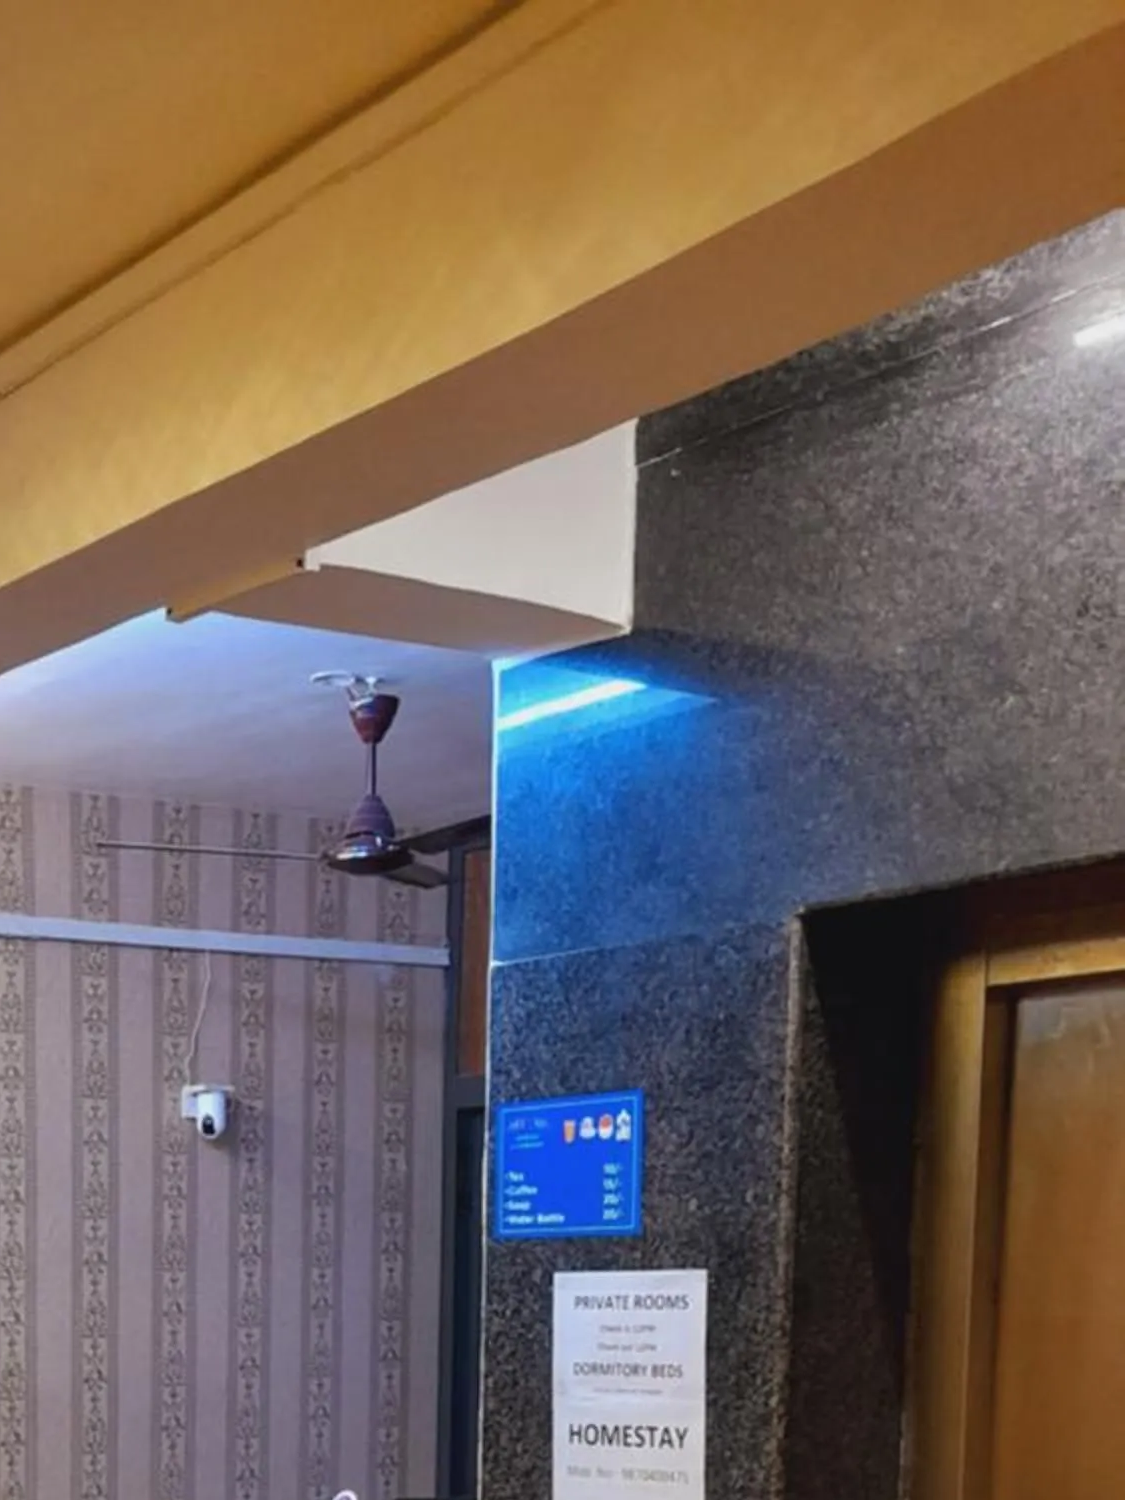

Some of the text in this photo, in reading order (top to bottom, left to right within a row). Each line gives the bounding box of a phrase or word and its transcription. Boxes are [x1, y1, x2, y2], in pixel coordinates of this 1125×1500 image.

[574, 1294, 690, 1311] PRIVATE ROOMS
[573, 1361, 684, 1379] DORMITORY BEDS
[568, 1423, 689, 1449] HOMESTAY
